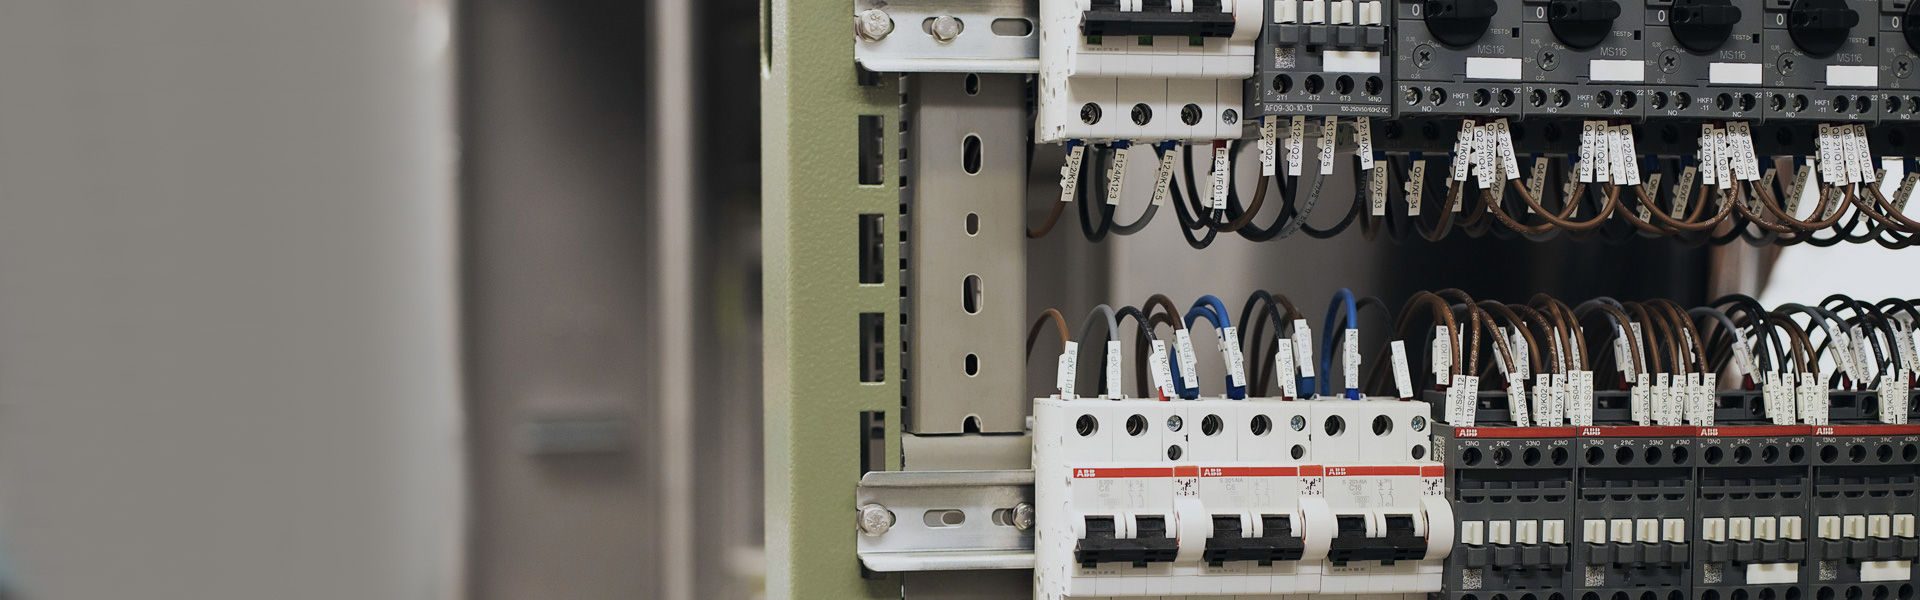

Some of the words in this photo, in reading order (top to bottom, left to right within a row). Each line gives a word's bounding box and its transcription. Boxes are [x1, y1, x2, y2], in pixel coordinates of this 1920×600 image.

[1412, 4, 1420, 16] 0
[1536, 7, 1545, 18] 0
[1657, 10, 1666, 22] 0
[1776, 13, 1784, 25] 0
[1891, 16, 1900, 28] 0
[1477, 45, 1505, 55] MS116
[1600, 47, 1628, 56] MS116
[1720, 50, 1747, 60] MS116
[1837, 53, 1863, 63] MS116
[1265, 122, 1274, 168] K12:2/Q2:1
[1291, 120, 1302, 168] K12:4/Q2:3
[1322, 120, 1334, 167] K12:6/Q2:5
[1456, 122, 1472, 178] Q2:21/K03:13
[1476, 130, 1487, 183] Q2:21/Q4:21
[1497, 122, 1515, 175] Q2:22/Q4:22
[1581, 124, 1592, 177] Q4:21/Q2:21
[1597, 124, 1605, 177] Q4:21/Q6:21
[1621, 128, 1636, 181] Q4:22/Q6:22
[1821, 126, 1832, 178] Q8:21/Q6:21
[1832, 127, 1844, 183] Q8:21/Q10:21
[1843, 127, 1858, 178] Q8:22/Q6:22
[1857, 125, 1873, 180] Q8:22/Q10:22
[1064, 151, 1081, 196] F12:2/K12:1
[1110, 153, 1125, 199] F12:4/K12:3
[1155, 155, 1173, 200] F12:6/K12:5
[1215, 149, 1225, 207] F12:11/F01:11
[1374, 166, 1384, 209] Q2:2/XF:33
[1410, 166, 1422, 209] Q2:4/XF:34
[1531, 163, 1545, 206] Q4:4/XF:3
[1065, 349, 1076, 394] F01:1/XP:8
[1157, 344, 1174, 394] F01:12/XL:11
[1181, 334, 1196, 383] F02:1/F03:1
[1282, 342, 1294, 395] F02:12/XL:12
[1440, 327, 1448, 384] K01:A1/K01:14
[1459, 429, 1478, 437] ABB
[1701, 428, 1719, 436] ABB
[1816, 427, 1834, 435] ABB
[1077, 469, 1096, 478] ABB
[1203, 468, 1222, 476] ABB
[1328, 468, 1347, 476] ABB
